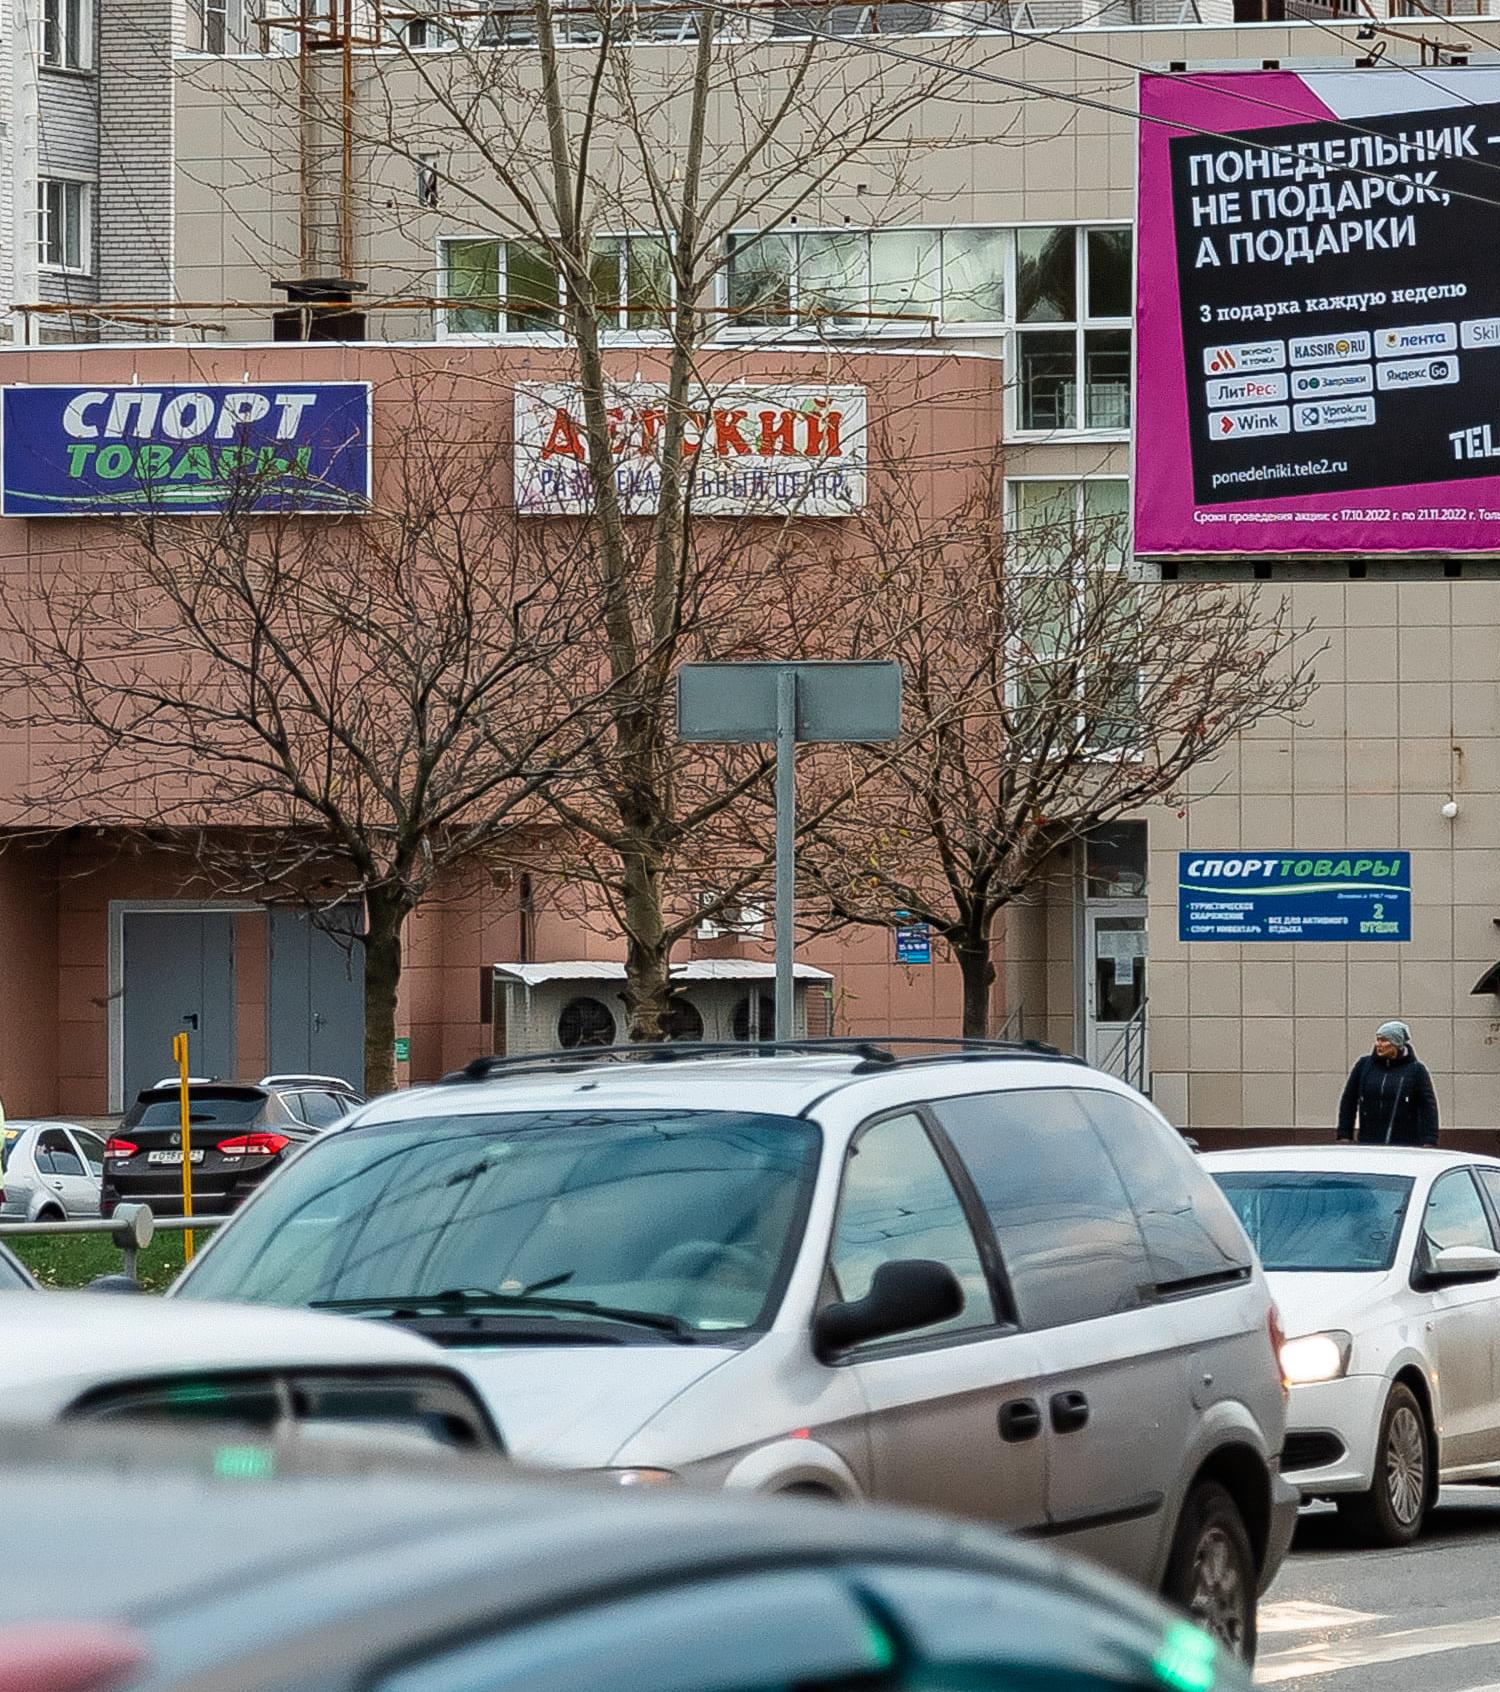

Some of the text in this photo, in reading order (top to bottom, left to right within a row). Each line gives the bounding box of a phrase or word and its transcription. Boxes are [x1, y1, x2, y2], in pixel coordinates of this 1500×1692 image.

[1189, 124, 1480, 187] ПОНЕДЕЛЬНИК
[1192, 171, 1451, 227] НЕ ПОДАРОК,
[1195, 214, 1417, 268] А ПОДАРКИ
[1200, 282, 1467, 323] 3 подарка каждую неделю
[1400, 333, 1447, 348] лента
[1386, 364, 1448, 382] Яндекс Go
[62, 391, 317, 440] СПОРТ
[1237, 414, 1279, 431] Wink
[67, 443, 313, 481] ТОВАРЫ
[1212, 459, 1348, 489] ponedelniki.tele2.ru
[1193, 510, 1226, 524] Сроки
[1229, 511, 1293, 524] проведения
[1332, 512, 1338, 522] с
[1341, 508, 1390, 521] 17.10.2022
[1392, 511, 1400, 521] г.
[1402, 511, 1415, 521] по
[1417, 508, 1467, 521] 21.11.2022
[1469, 511, 1476, 521] г.
[1372, 903, 1385, 920] 2
